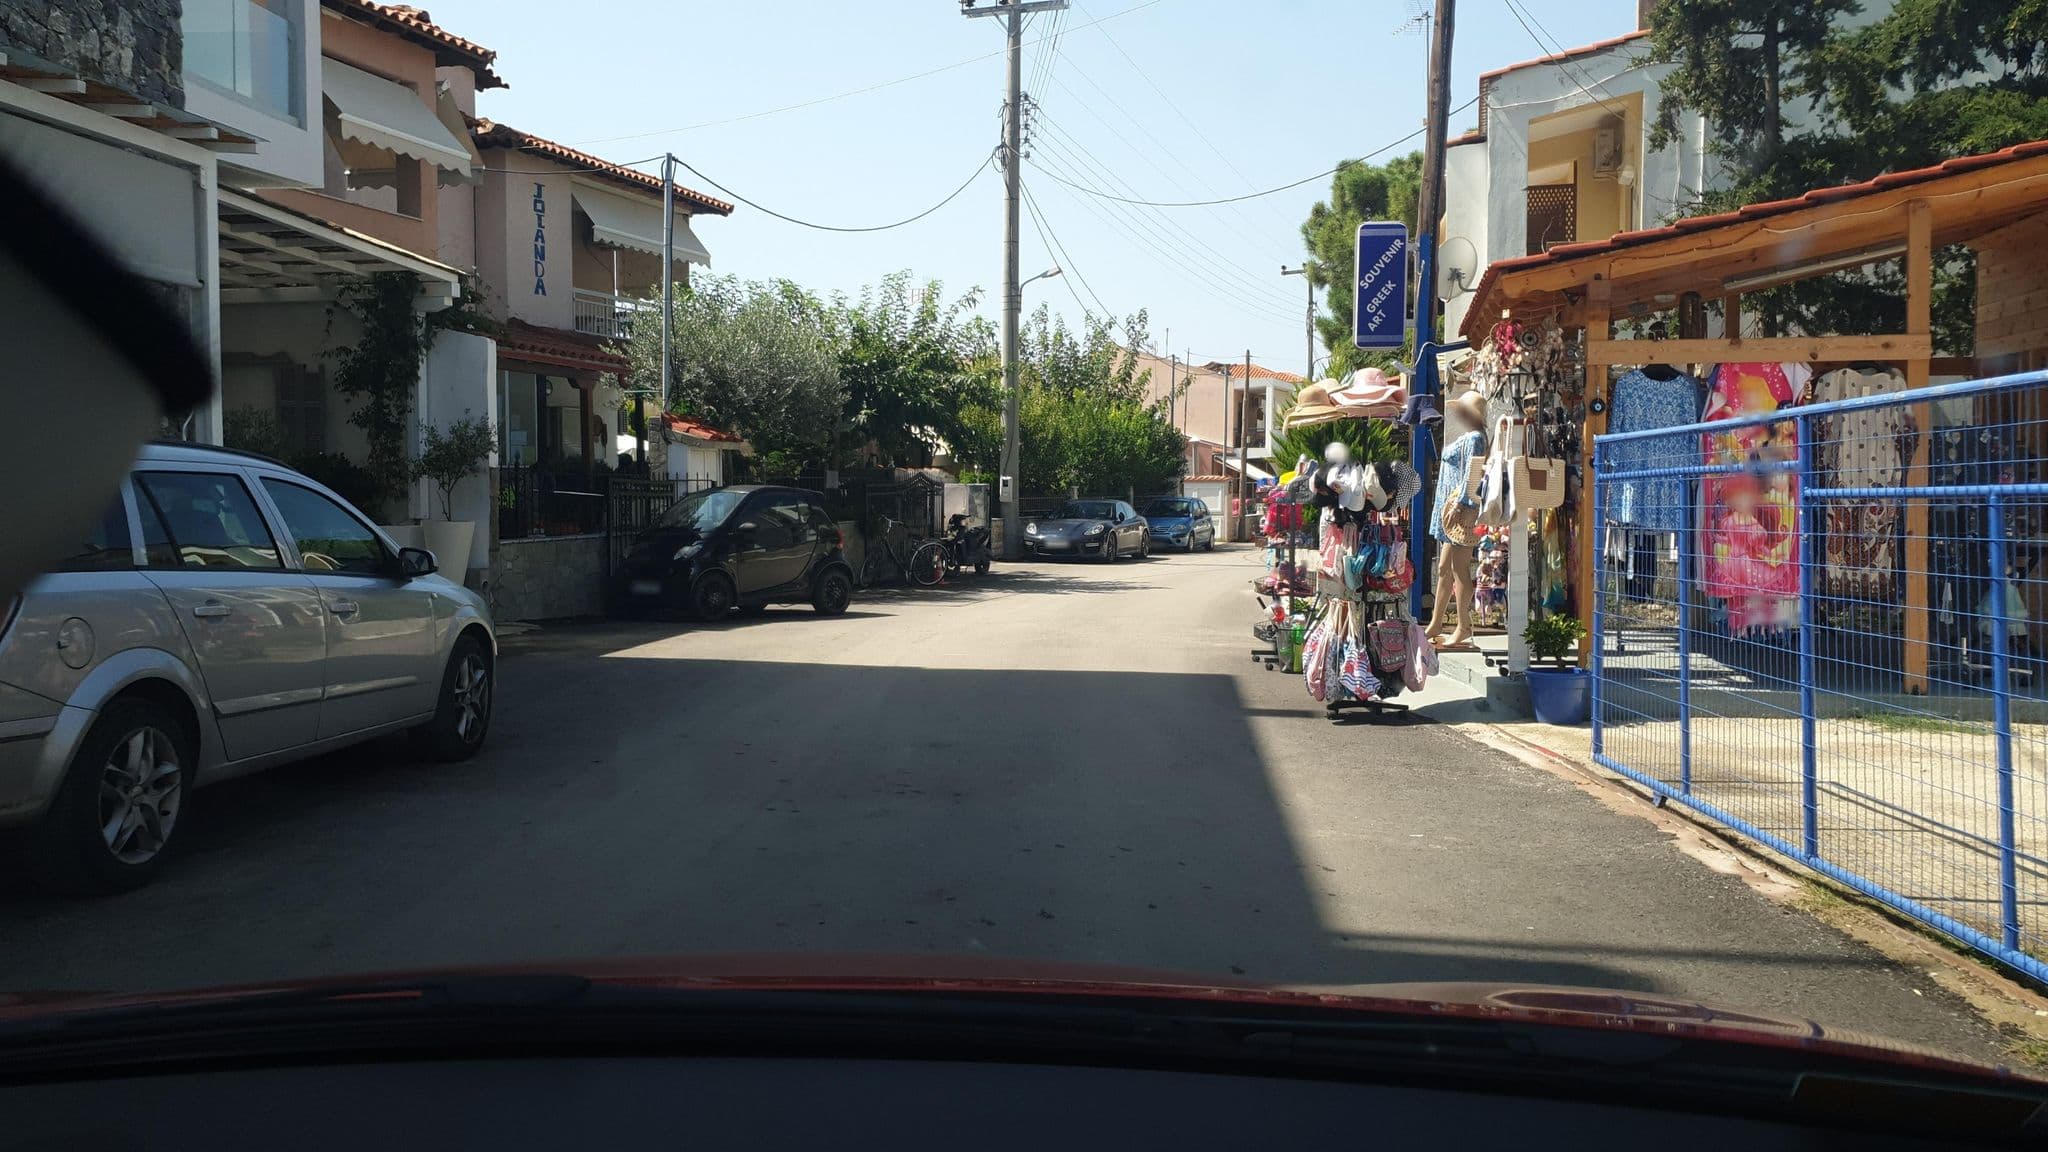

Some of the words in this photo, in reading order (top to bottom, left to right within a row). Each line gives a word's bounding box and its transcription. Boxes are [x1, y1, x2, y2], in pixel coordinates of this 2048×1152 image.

[533, 182, 546, 296] JOLANDA
[1360, 238, 1404, 289] SOUVENIR
[1367, 280, 1396, 314] GREEK
[1367, 309, 1386, 332] ART
